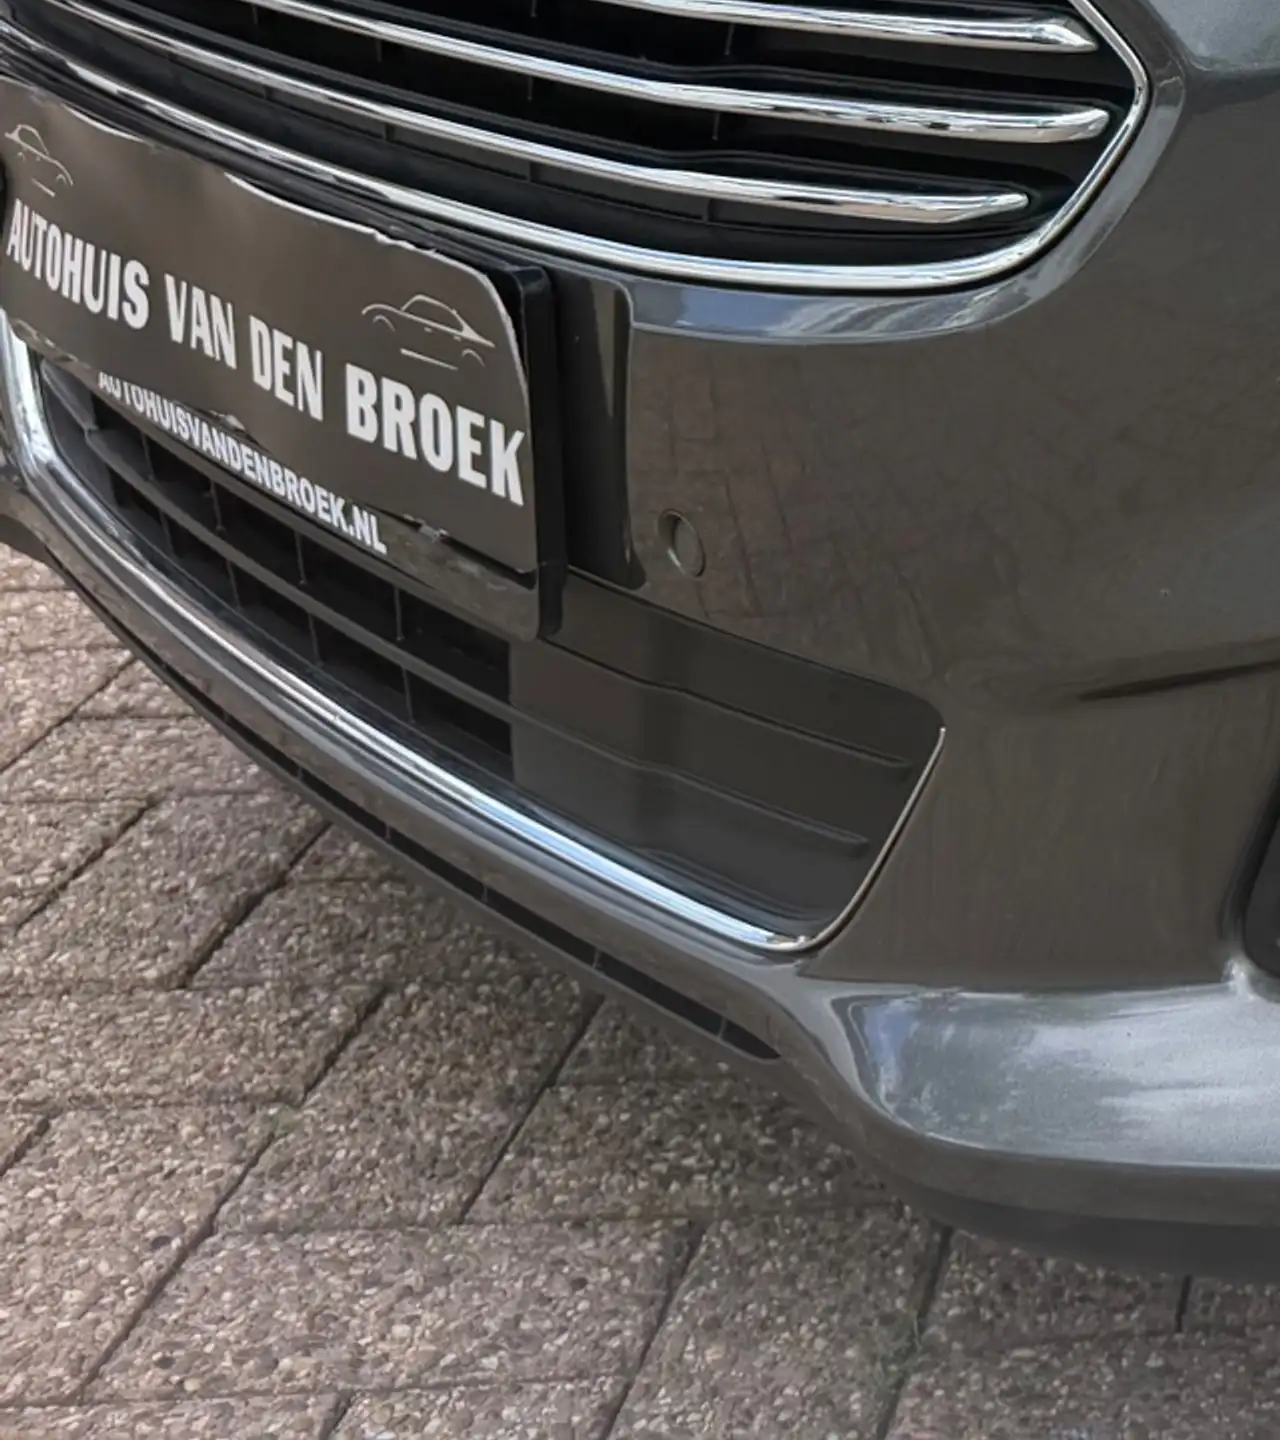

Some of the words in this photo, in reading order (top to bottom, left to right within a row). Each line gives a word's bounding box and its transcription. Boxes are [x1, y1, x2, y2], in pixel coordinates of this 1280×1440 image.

[6, 198, 150, 330] AUTOHUIS
[164, 273, 238, 370] VAN
[248, 314, 325, 422] DEN
[344, 363, 526, 507] BROEK
[97, 370, 388, 556] AUTOHUISVANDENBROEK.NL
